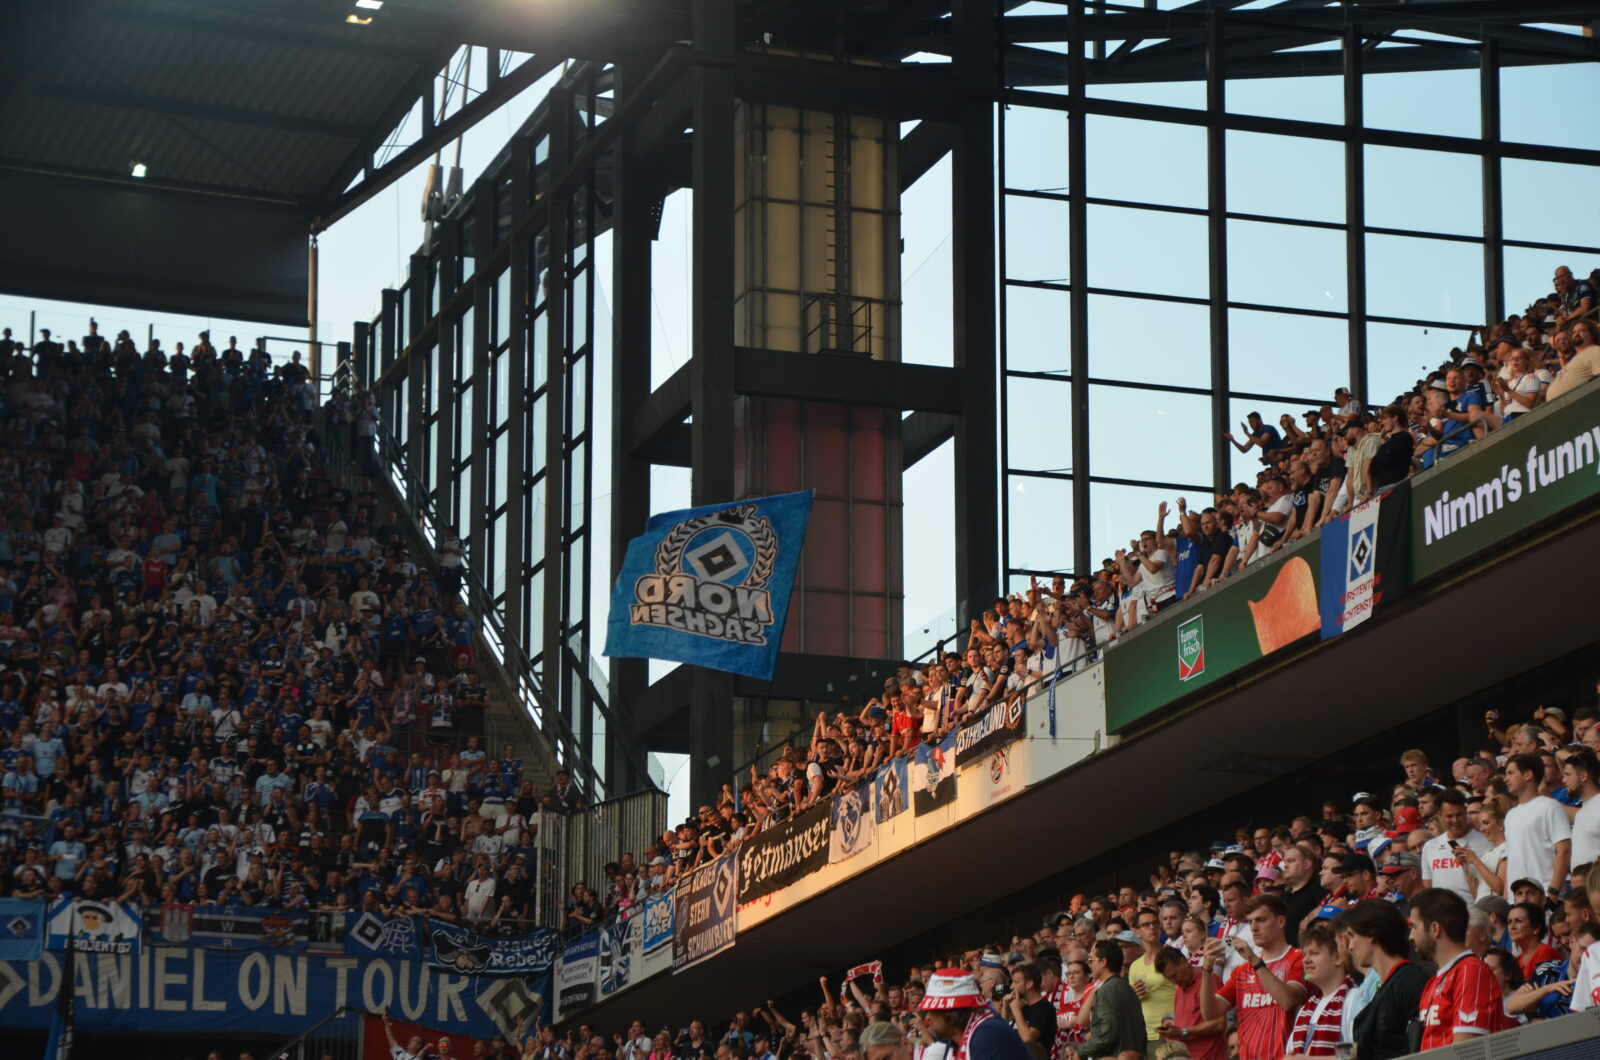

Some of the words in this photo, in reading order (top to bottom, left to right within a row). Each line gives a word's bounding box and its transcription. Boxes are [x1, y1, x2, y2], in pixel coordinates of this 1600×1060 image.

[1424, 464, 1522, 546] Nimm's
[1432, 857, 1460, 870] REW
[689, 896, 711, 928] STERN
[28, 946, 227, 1011] DANIEL
[237, 952, 309, 1016] ON
[326, 957, 470, 1022] TOUR
[922, 996, 956, 1009] KÖLN
[1242, 992, 1277, 1009] REW
